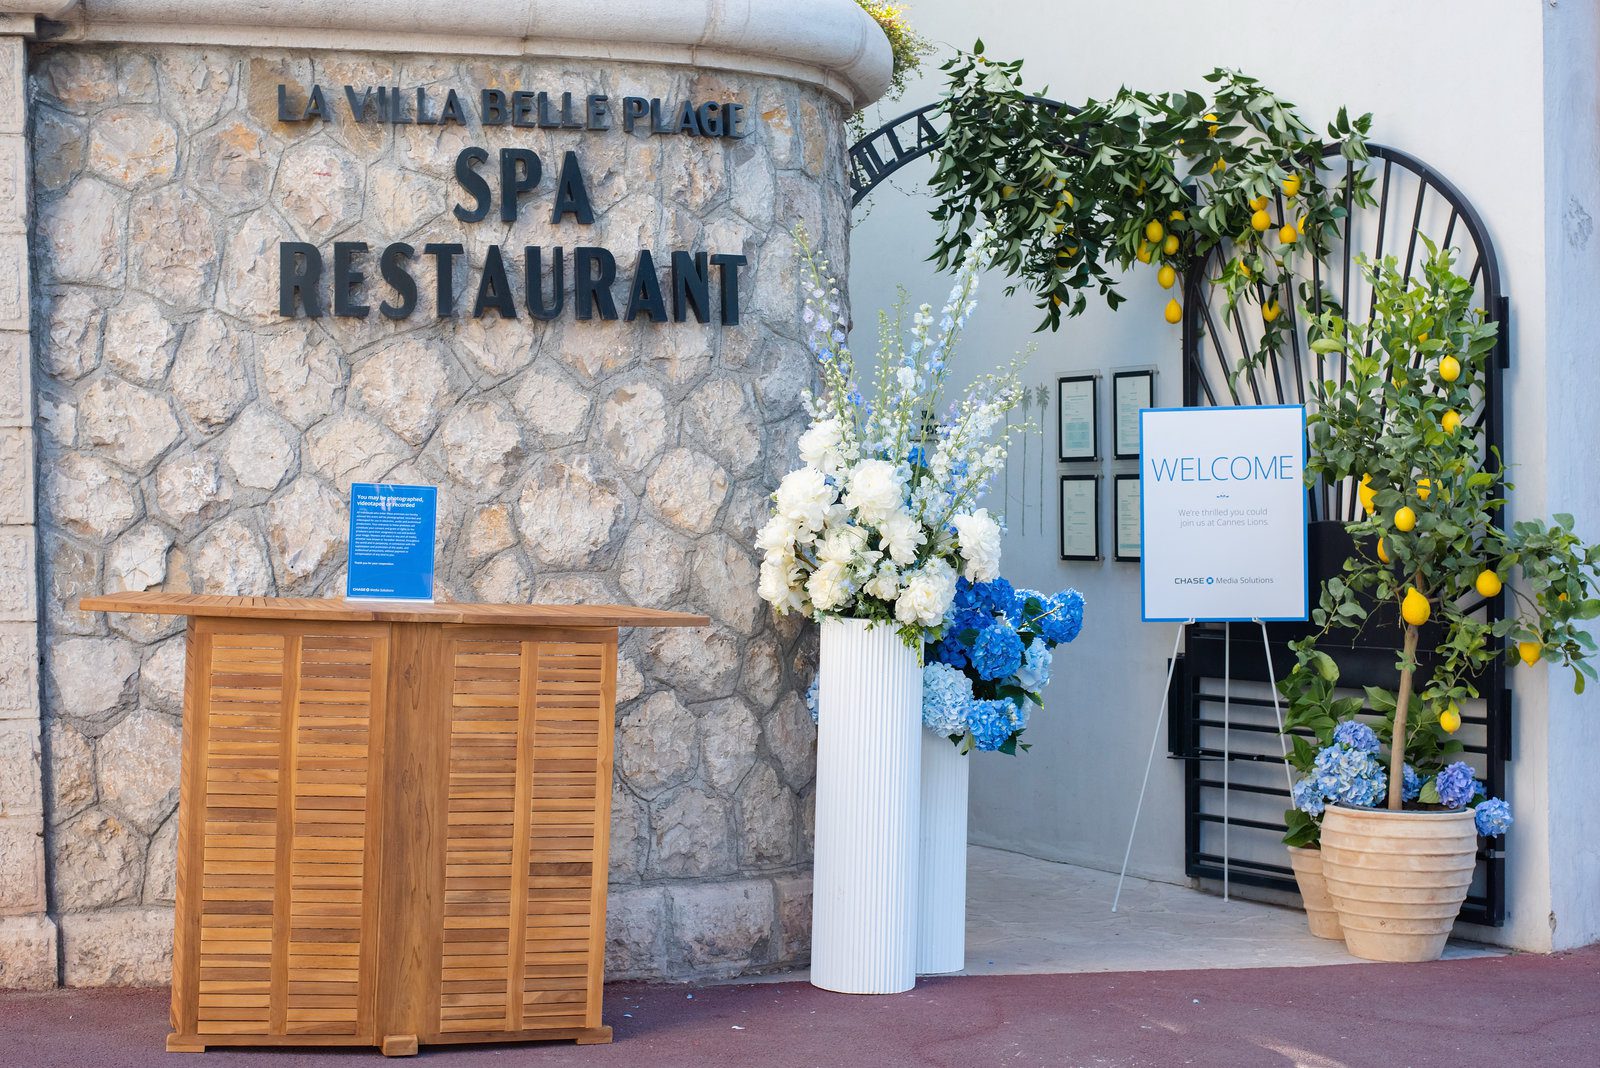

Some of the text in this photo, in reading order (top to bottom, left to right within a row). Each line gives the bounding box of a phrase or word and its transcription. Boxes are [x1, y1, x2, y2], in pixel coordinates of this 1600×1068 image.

[277, 84, 744, 138] LA VILLA BELLE PLAGE
[452, 146, 595, 225] SPA
[279, 241, 748, 326] RESTAURANT
[1151, 455, 1294, 482] WELCOME
[387, 496, 424, 504] photographed,
[1178, 507, 1268, 518] We're thrilled you could
[1180, 519, 1194, 528] join
[1207, 519, 1215, 527] at
[1216, 519, 1245, 527] Cannes
[1247, 518, 1269, 526] Lions.
[1240, 576, 1274, 584] Solutions
